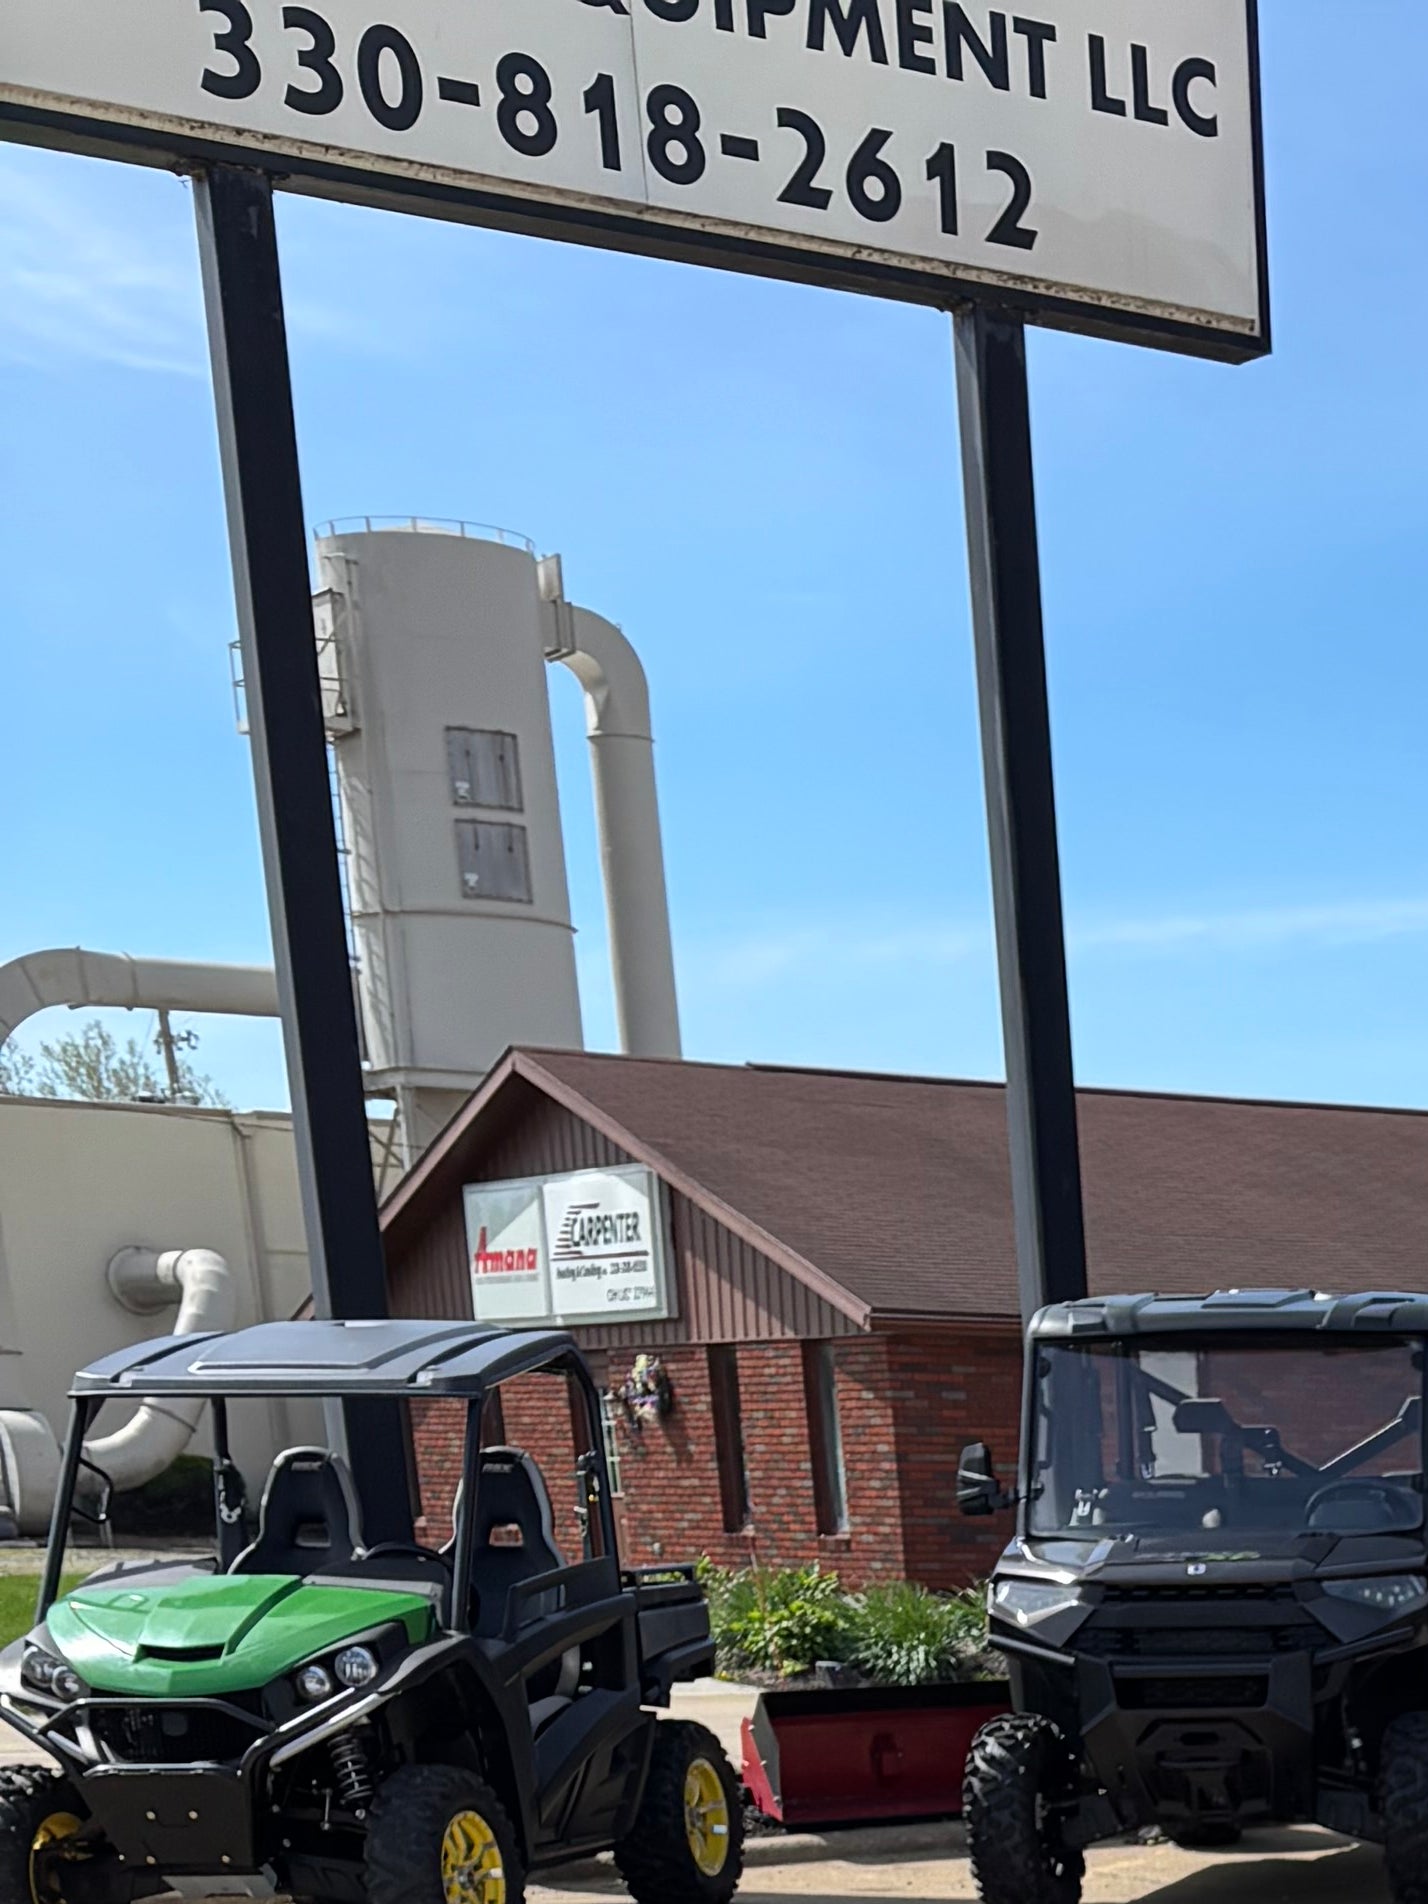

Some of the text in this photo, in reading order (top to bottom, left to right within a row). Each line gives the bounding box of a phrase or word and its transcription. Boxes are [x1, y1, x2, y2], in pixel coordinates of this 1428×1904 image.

[578, 0, 1219, 138] PMENT LLC
[200, 1, 1039, 250] 330-818-2612
[474, 1226, 538, 1274] Amana
[570, 1211, 642, 1248] CARPENTER
